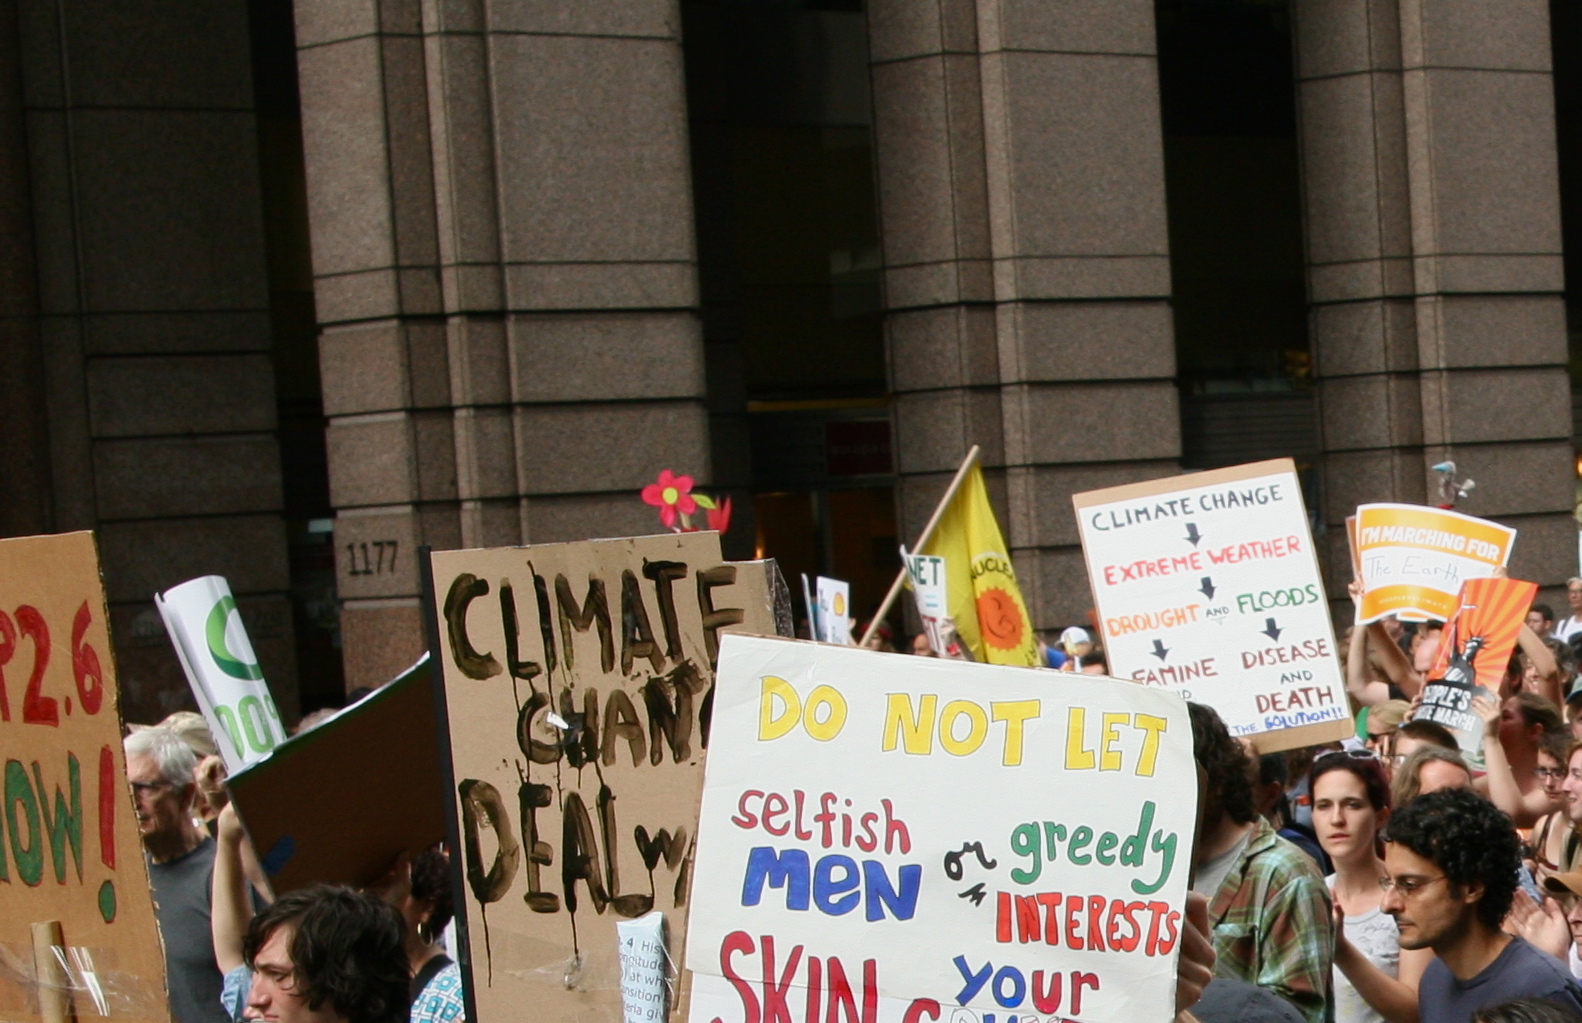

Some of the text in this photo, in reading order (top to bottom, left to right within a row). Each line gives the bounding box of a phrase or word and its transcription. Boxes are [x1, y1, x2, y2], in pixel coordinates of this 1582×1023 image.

[1090, 484, 1284, 532] CLIMATE CHANGE
[347, 540, 398, 576] 1177
[1103, 534, 1301, 586] EXTREME WEATHER
[1361, 526, 1500, 562] I'M MARCHING FOR
[1365, 555, 1460, 584] The Earth
[444, 556, 745, 682] CLIMATE
[1106, 583, 1320, 637] DROUGHT AND FLOODS
[1131, 639, 1331, 687] FAMINE DISEASE
[1280, 670, 1313, 685] AND
[1255, 685, 1335, 714] DEATH
[1433, 707, 1476, 732] MARCH
[757, 674, 1168, 778] DO NOT LET
[1233, 723, 1258, 736] THE
[732, 789, 912, 855] selfish
[458, 778, 656, 918] DEAL
[944, 840, 997, 882] or
[1010, 801, 1179, 895] greedy
[995, 890, 1181, 957] INTERESTS
